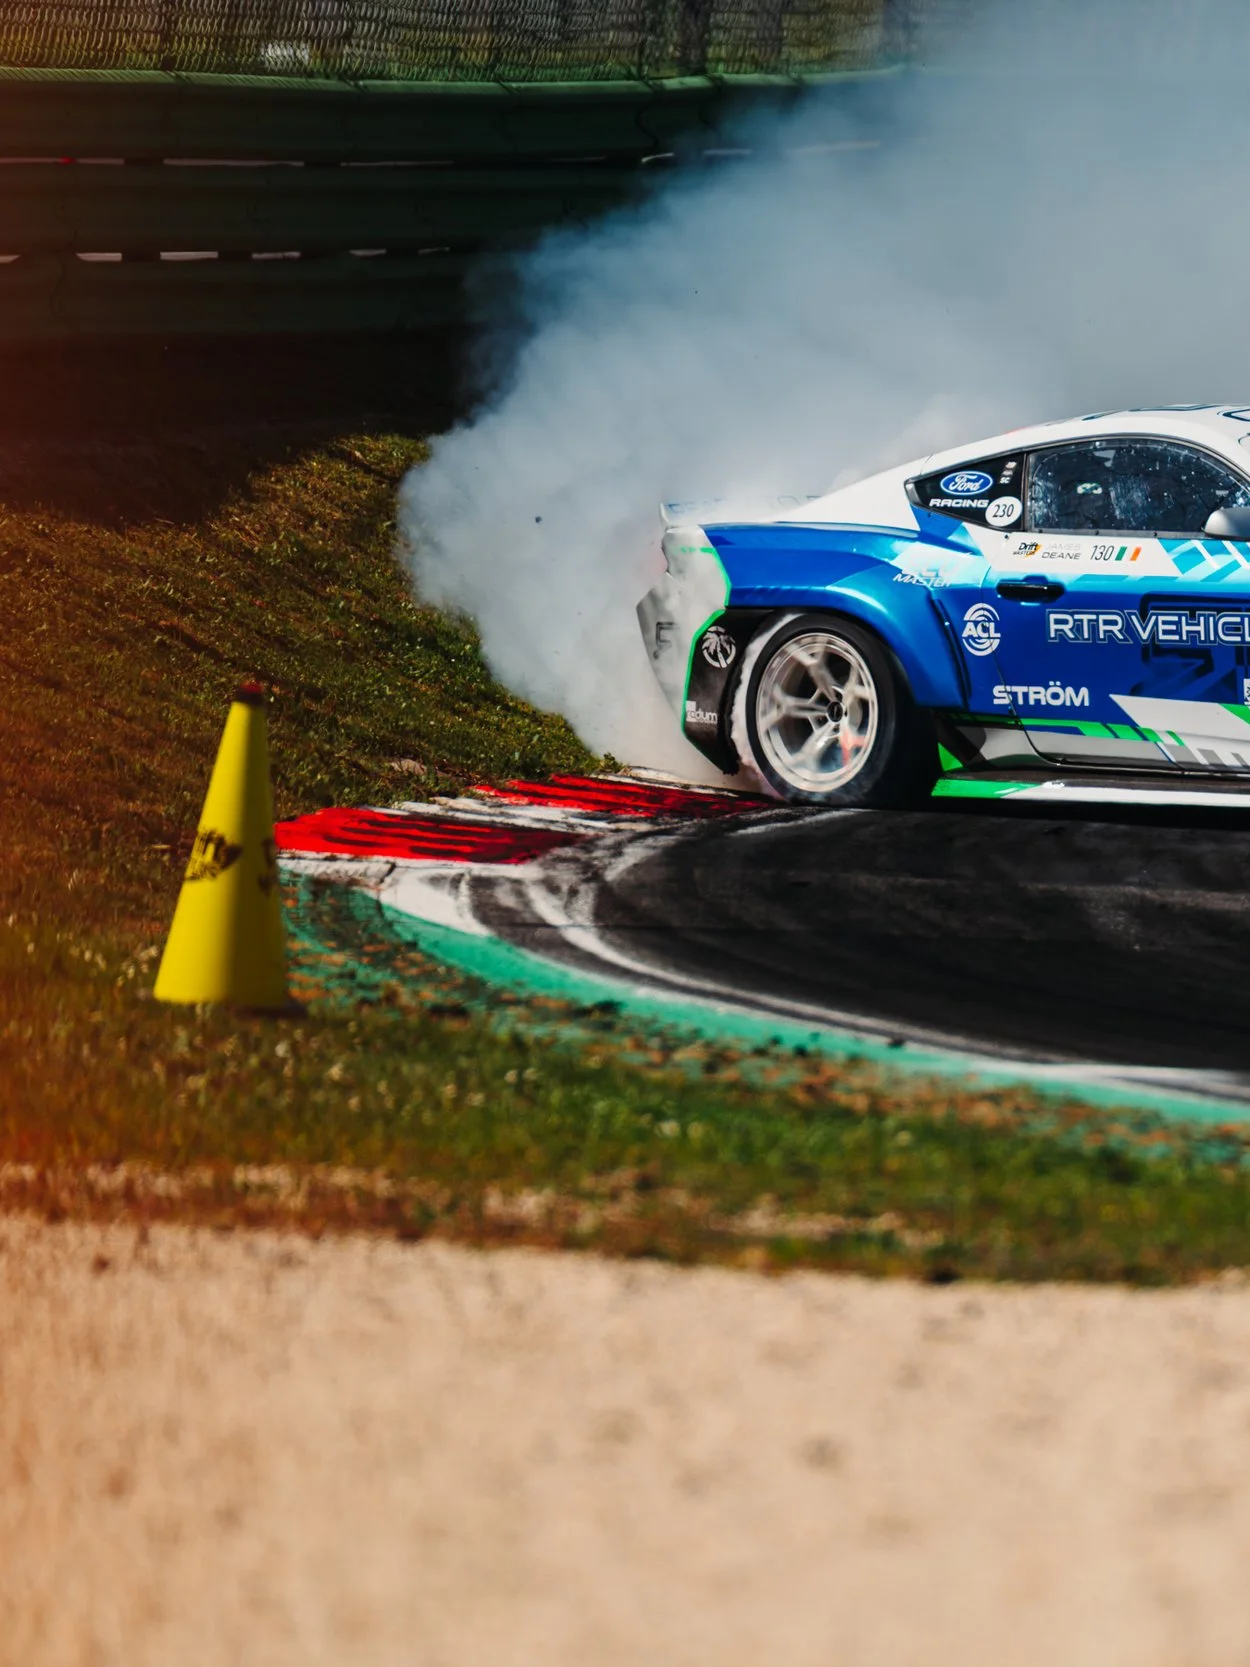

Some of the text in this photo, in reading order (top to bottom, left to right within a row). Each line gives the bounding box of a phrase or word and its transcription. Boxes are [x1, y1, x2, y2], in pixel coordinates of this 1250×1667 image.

[948, 474, 985, 491] Ford
[929, 499, 990, 508] RACING
[992, 503, 1016, 518] 230
[1041, 551, 1082, 560] DEANE
[1090, 545, 1115, 561] 130
[962, 622, 1001, 638] ACL
[1048, 612, 1126, 641] RTR
[993, 681, 1090, 707] STRÖM
